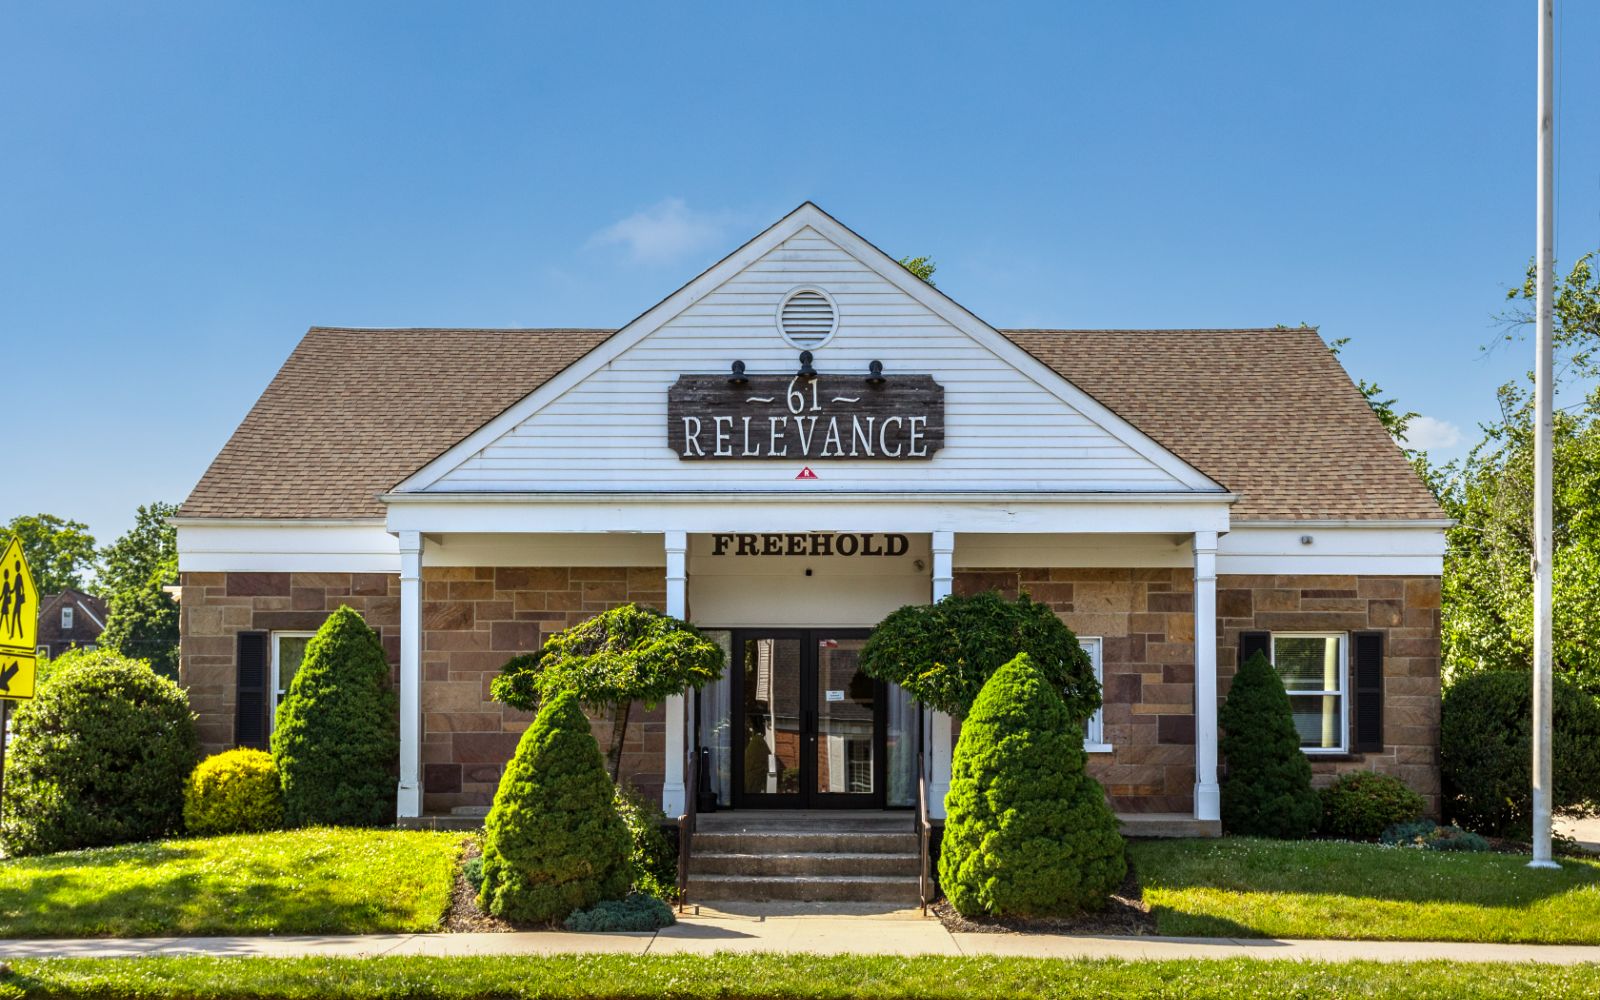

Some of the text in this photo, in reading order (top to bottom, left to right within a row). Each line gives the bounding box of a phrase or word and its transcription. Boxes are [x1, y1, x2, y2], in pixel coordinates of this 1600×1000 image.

[787, 376, 822, 414] 61
[682, 414, 928, 457] RELEVANCE
[711, 533, 909, 556] FREEHOLD
